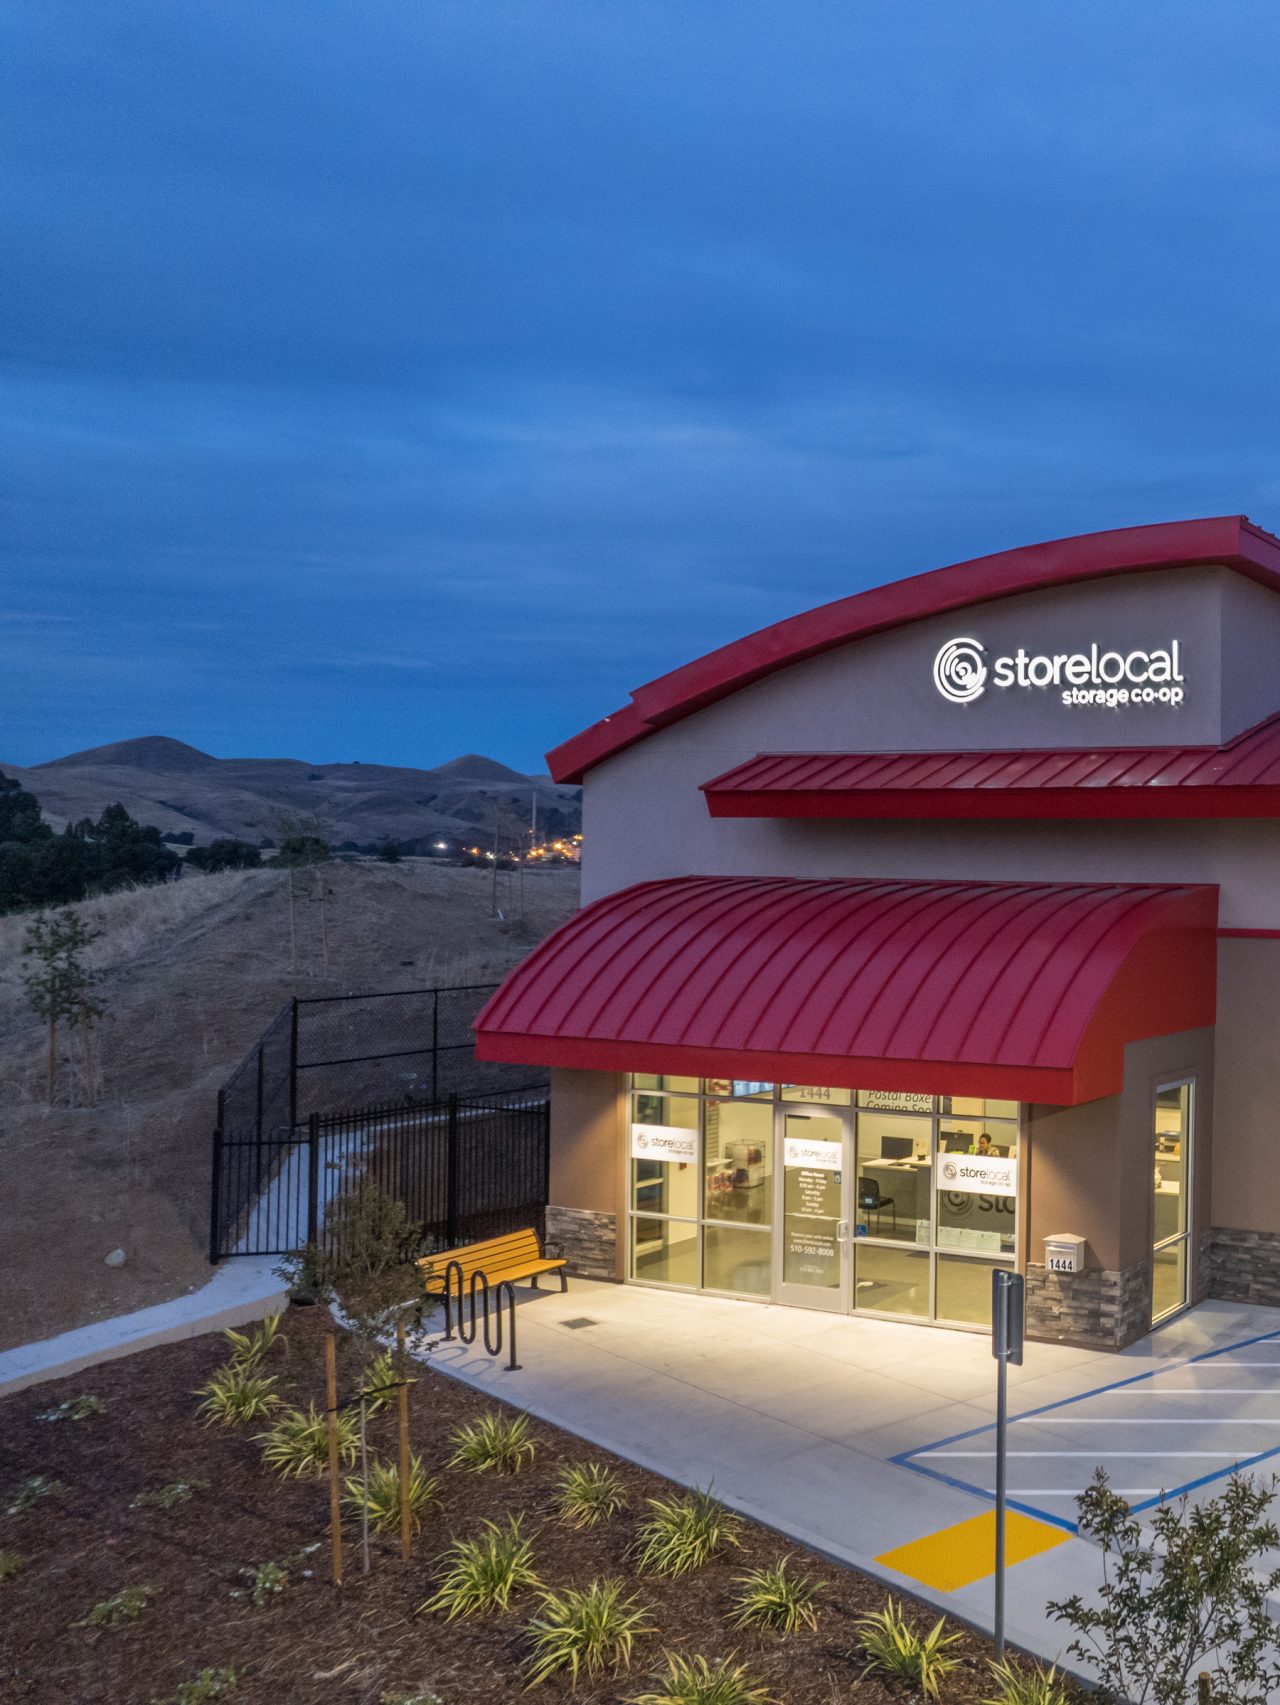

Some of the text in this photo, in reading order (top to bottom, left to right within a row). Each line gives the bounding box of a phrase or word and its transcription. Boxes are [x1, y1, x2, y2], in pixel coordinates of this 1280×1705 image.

[993, 639, 1184, 687] storelocal
[1062, 686, 1129, 708] storage
[800, 1086, 831, 1100] 1444
[651, 1137, 696, 1151] storelocal
[959, 1166, 1011, 1181] storelocal
[1050, 1258, 1073, 1271] 1444
